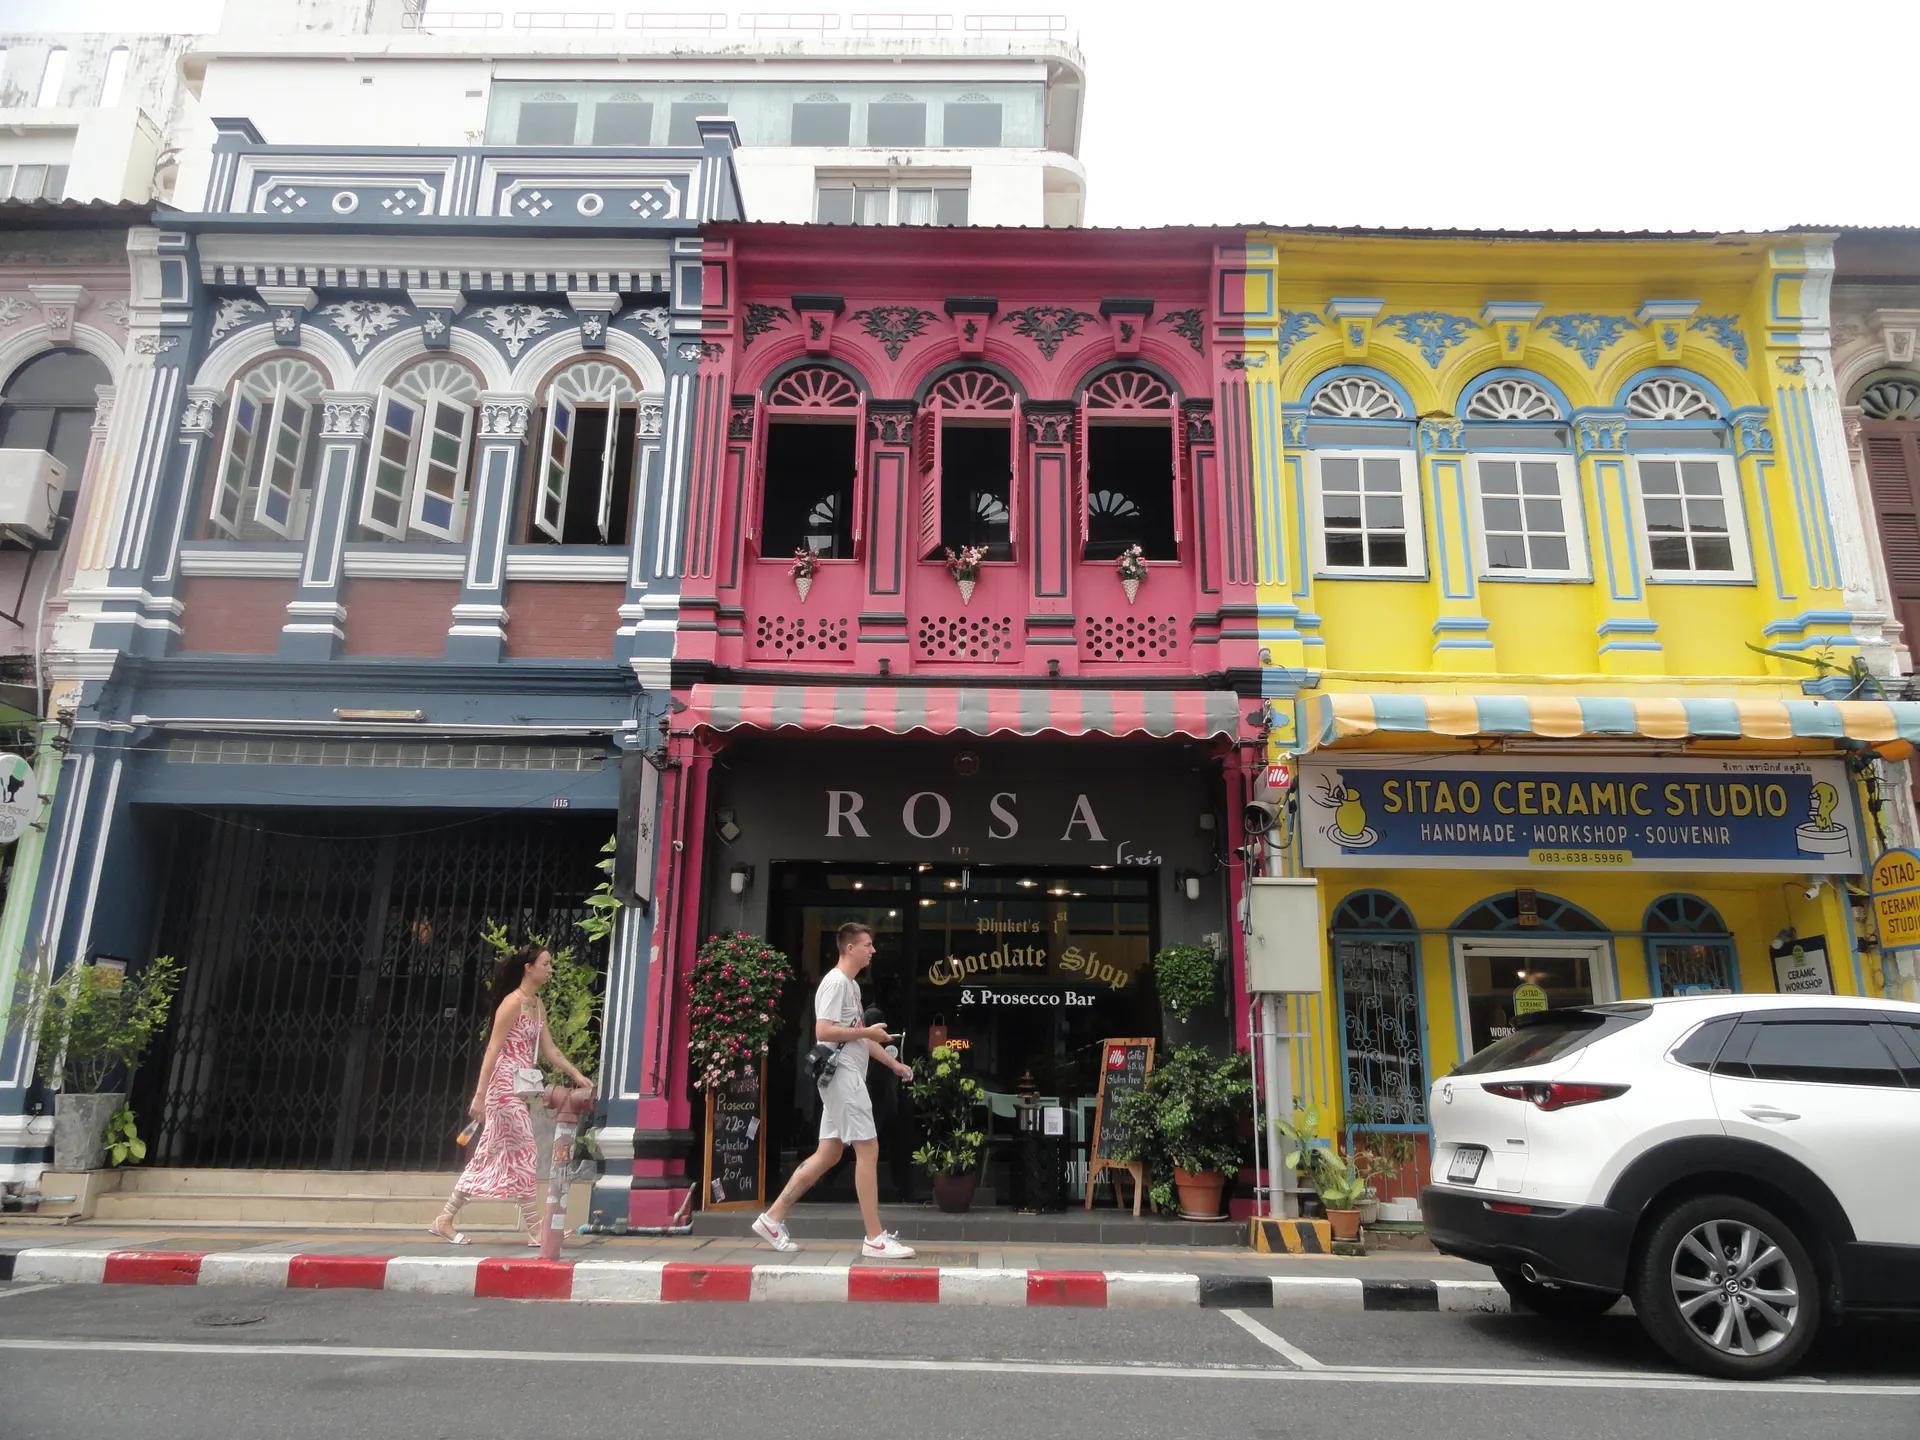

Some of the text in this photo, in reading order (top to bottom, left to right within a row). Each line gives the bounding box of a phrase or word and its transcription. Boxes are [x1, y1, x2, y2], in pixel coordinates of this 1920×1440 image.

[1269, 768, 1288, 785] illy
[1382, 779, 1788, 817] SITAO CERAMIC STUDIO
[824, 790, 1108, 841] ROSA
[1420, 823, 1731, 845] HANDMADE WORKSHOP SOUVENIR
[1538, 852, 1623, 864] 083-638-5996
[1881, 898, 1920, 916] CERAMI
[976, 916, 1040, 935] Phuket's
[928, 942, 1129, 991] Chocolate Shop
[1788, 967, 1816, 981] CERAMIC
[1785, 978, 1823, 993] WORKSHOP
[960, 989, 1096, 1006] & Prosecco Bar
[1490, 1026, 1516, 1038] WORKS
[945, 1039, 970, 1049] OPEN
[1109, 1050, 1125, 1067] illy
[716, 1092, 755, 1112] Prosecco
